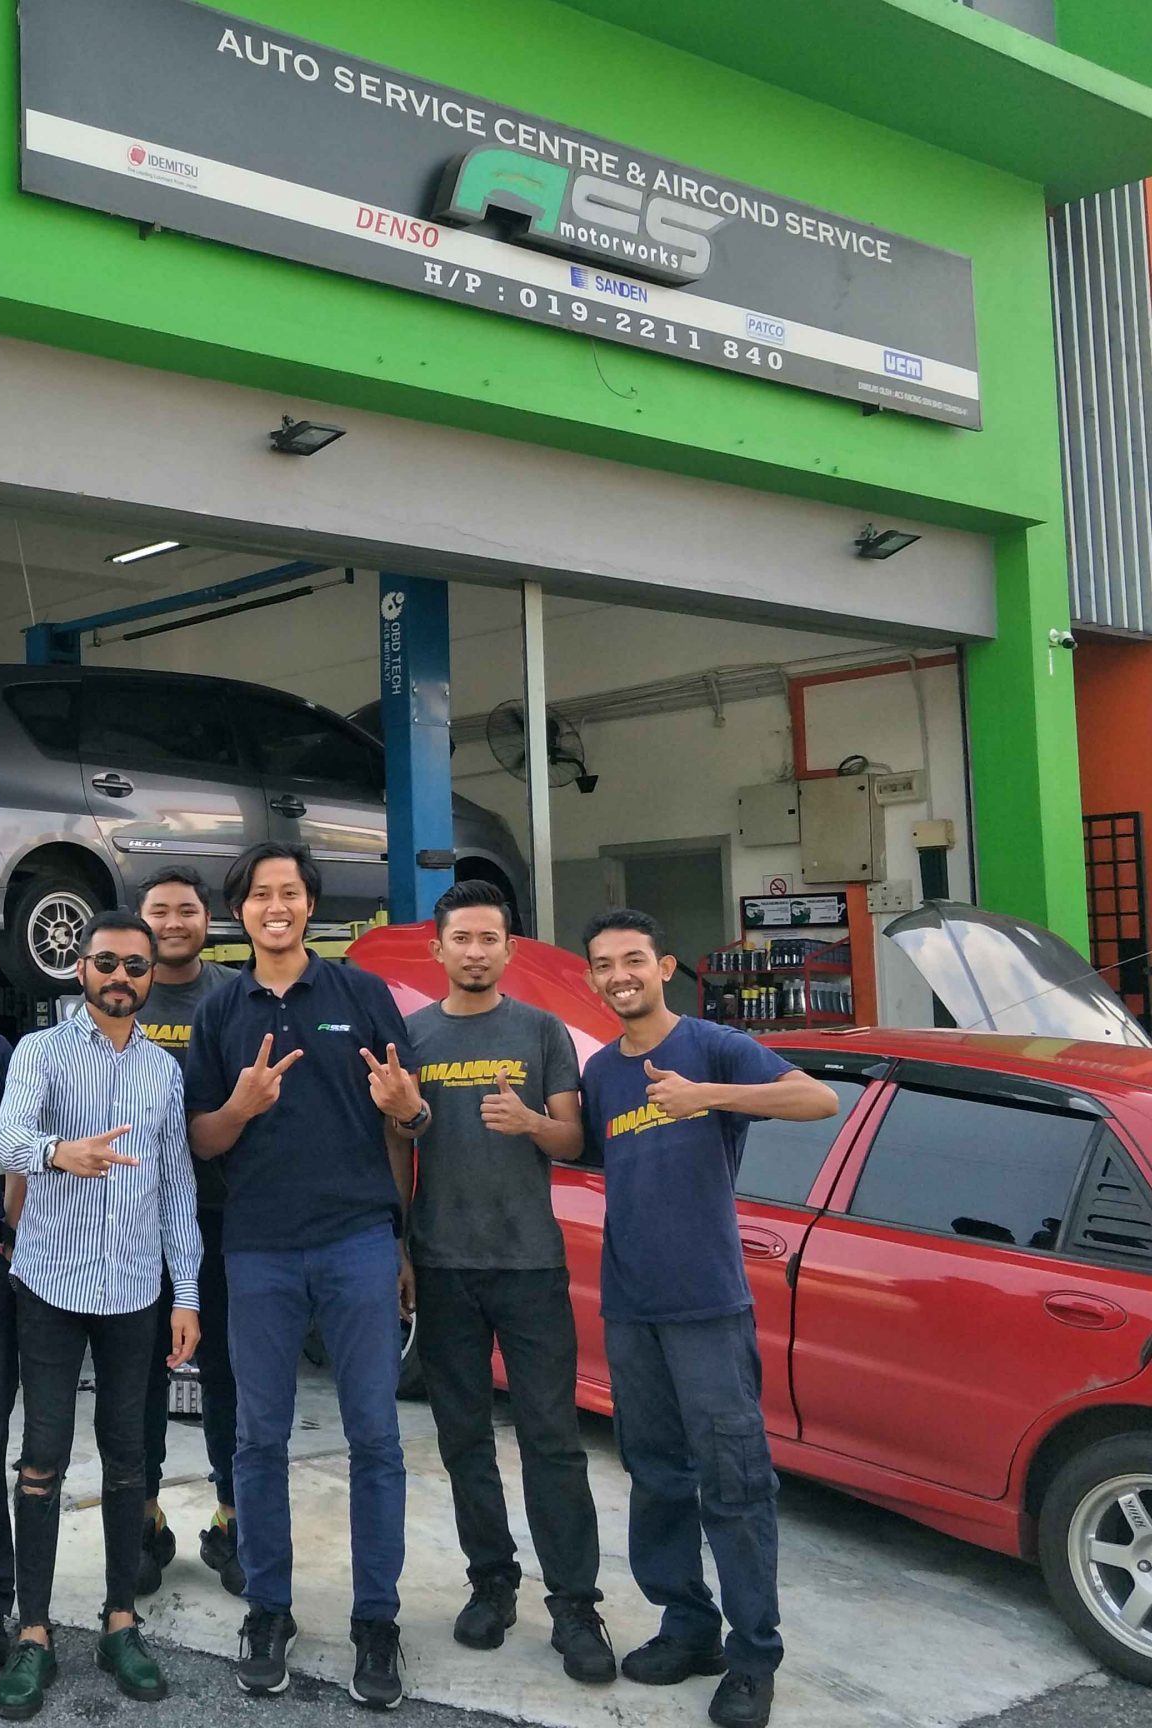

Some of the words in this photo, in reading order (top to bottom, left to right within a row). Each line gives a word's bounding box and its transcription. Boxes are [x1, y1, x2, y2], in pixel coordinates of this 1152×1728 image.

[148, 154, 198, 178] IDEMITSU
[217, 28, 320, 81] AUTO
[334, 66, 486, 137] SERVICE
[494, 118, 619, 179] CENTRE
[626, 162, 646, 187] &
[652, 169, 779, 228] AIRCOND
[785, 212, 893, 263] SERVICE
[355, 207, 440, 249] DENSO
[453, 148, 725, 275] ACS
[559, 221, 679, 269] motorworks
[595, 275, 647, 304] SANDEN
[423, 262, 482, 294] H/P
[519, 288, 701, 350] 019-2211
[723, 340, 783, 371] 840
[748, 318, 784, 338] PATCO
[391, 622, 401, 652] OBD
[391, 655, 402, 695] TECH
